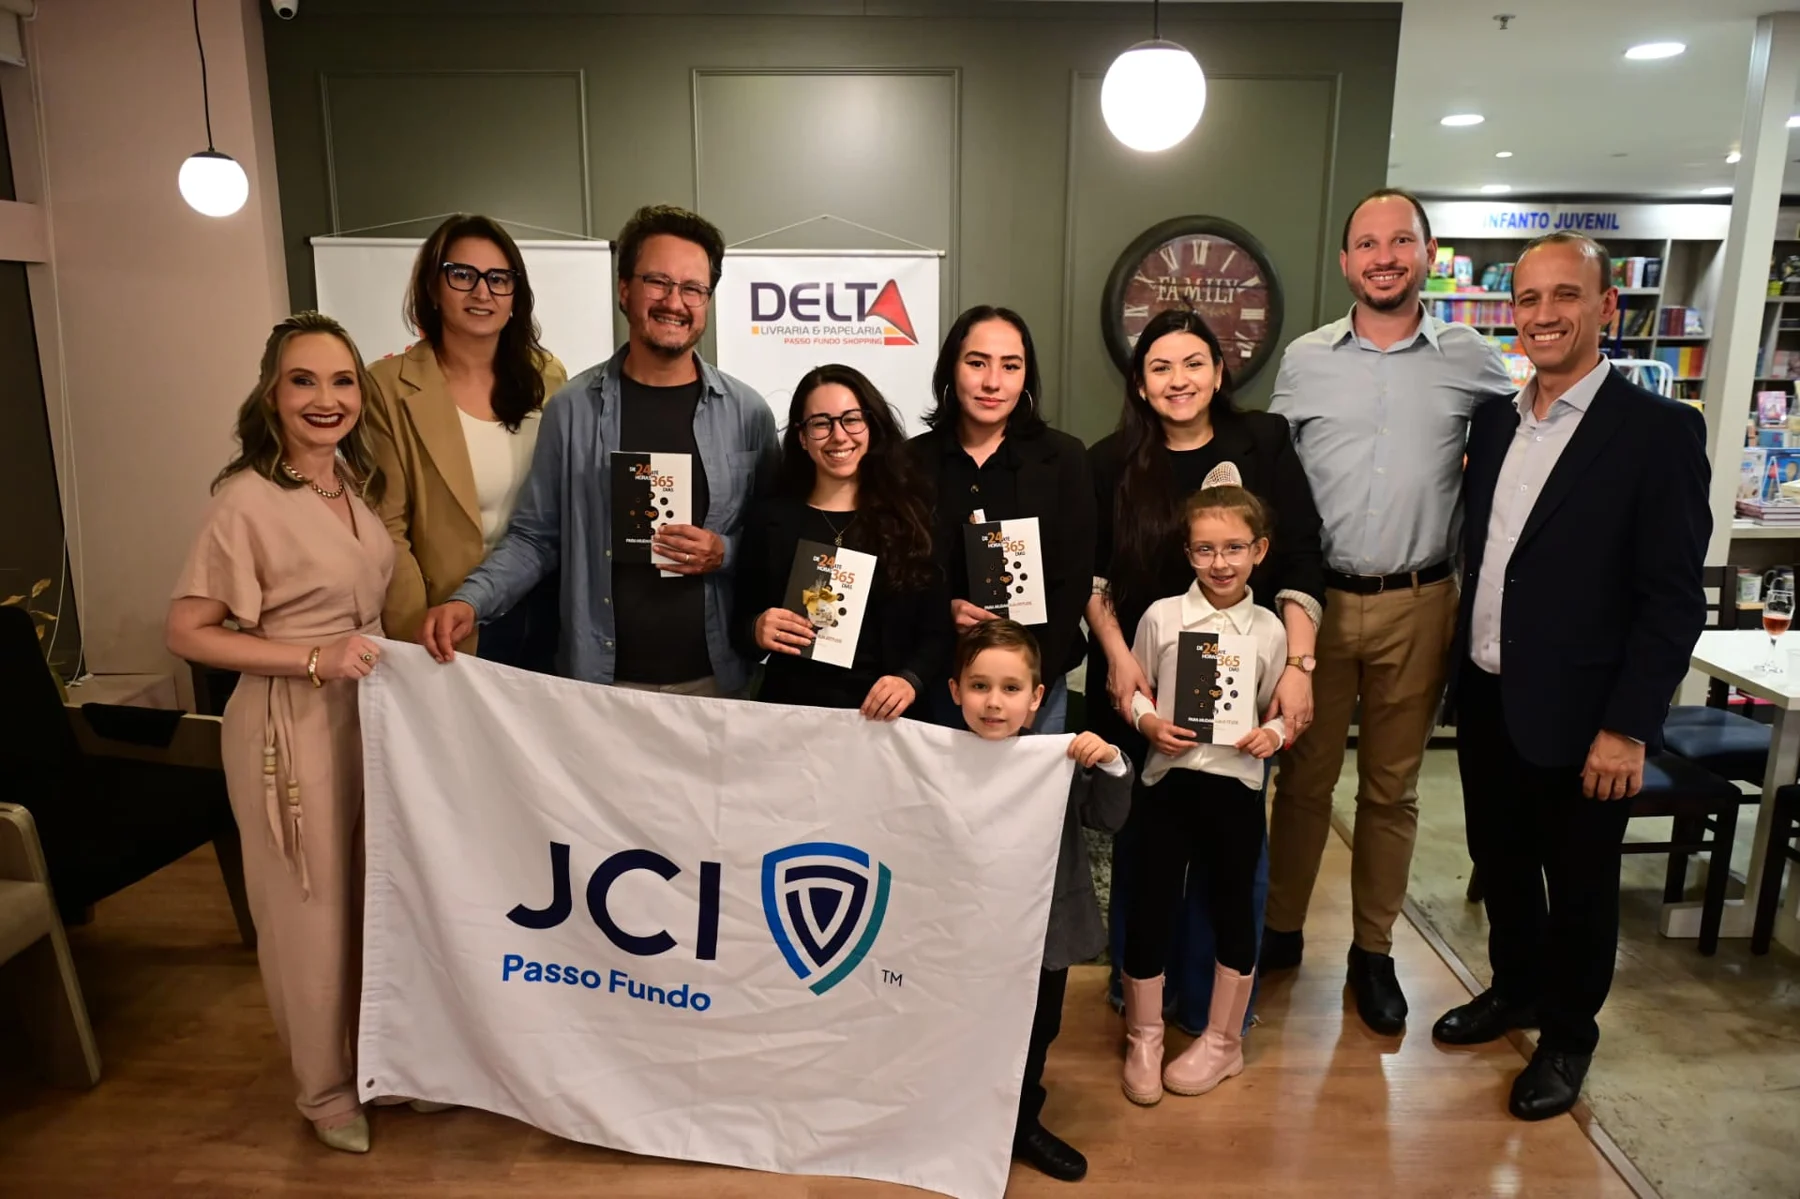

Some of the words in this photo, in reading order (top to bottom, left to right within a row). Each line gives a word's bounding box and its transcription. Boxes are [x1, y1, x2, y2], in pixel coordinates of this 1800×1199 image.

[1553, 212, 1620, 230] JUVENIL
[1156, 276, 1239, 304] FAMILY
[760, 326, 809, 336] LIVRARIA
[812, 326, 820, 335] &
[823, 326, 882, 336] PAPELARIA
[635, 464, 651, 476] 24
[650, 476, 674, 487] 365
[987, 531, 1003, 544] 24
[1003, 540, 1025, 552] 365
[819, 554, 835, 568] 24
[831, 568, 856, 585] 365
[1202, 642, 1218, 655] 24
[1217, 655, 1240, 667] 365
[506, 841, 721, 960] JCI
[502, 954, 601, 989] Passo
[609, 969, 711, 1011] Fundo
